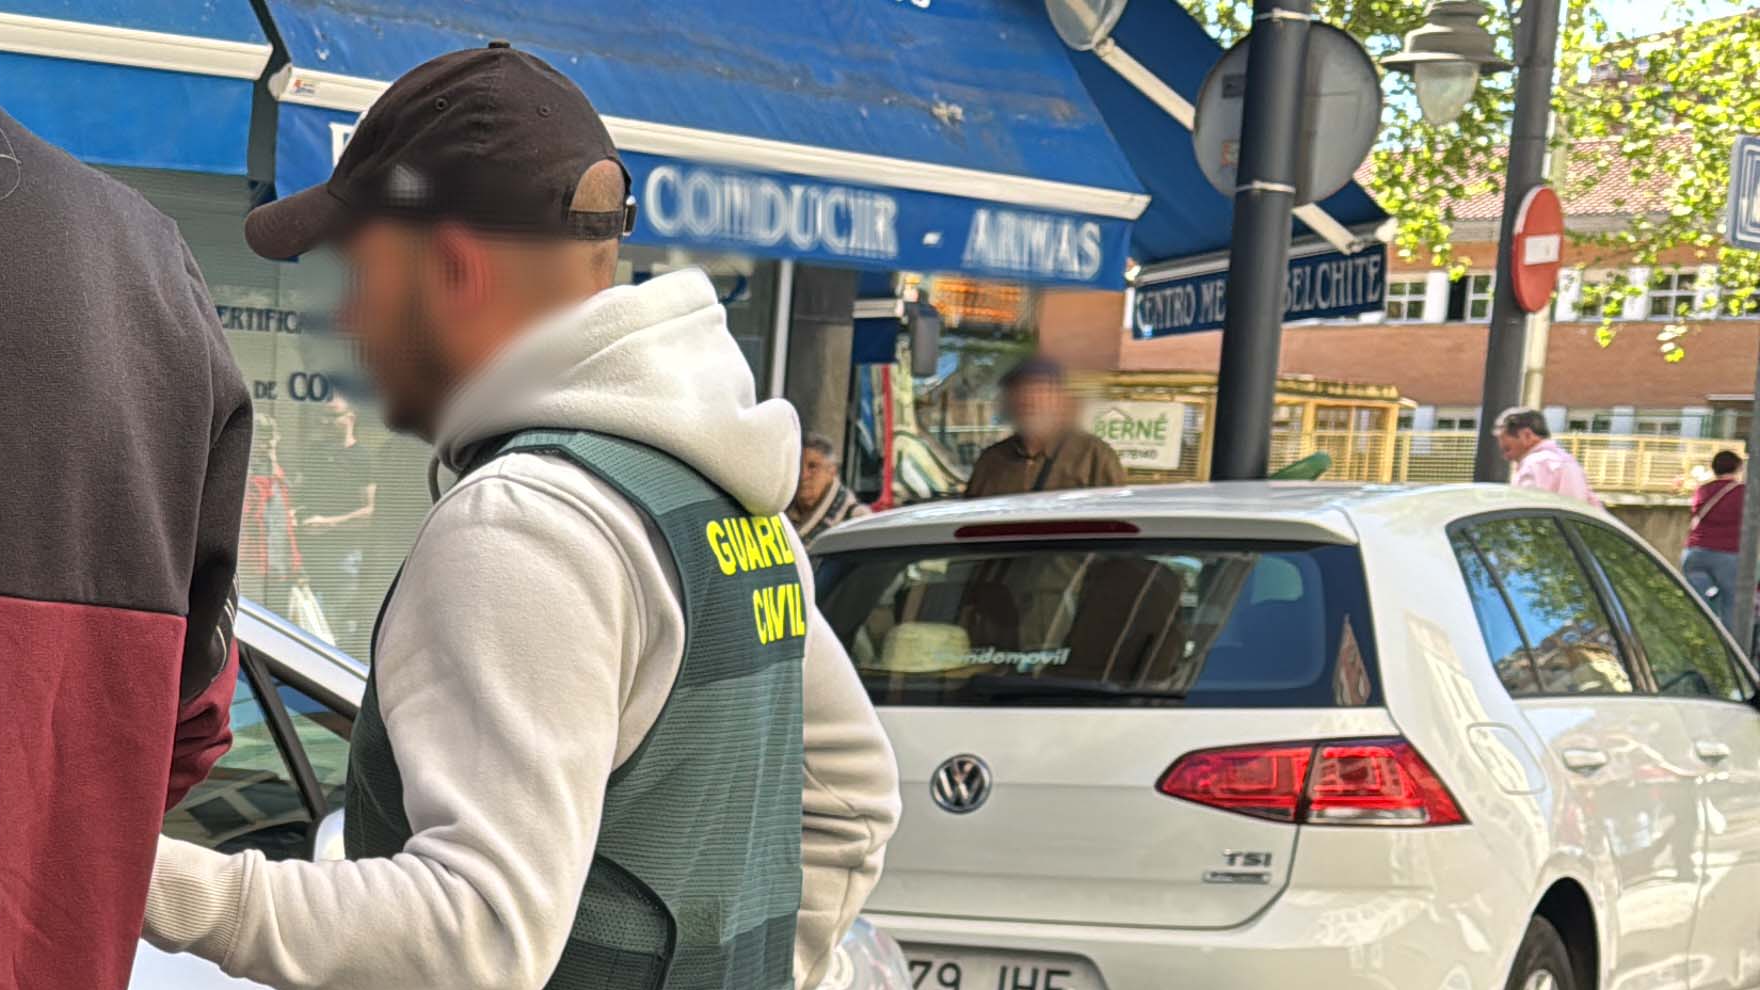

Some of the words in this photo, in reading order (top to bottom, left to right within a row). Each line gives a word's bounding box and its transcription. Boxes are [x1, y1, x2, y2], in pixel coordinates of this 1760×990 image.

[644, 164, 899, 259] CONDUCIR
[962, 207, 1103, 281] ARMAS
[1136, 284, 1196, 331] CENTRO
[1199, 278, 1227, 324] ME
[752, 582, 807, 645] CIVIL
[1223, 850, 1272, 867] TSI
